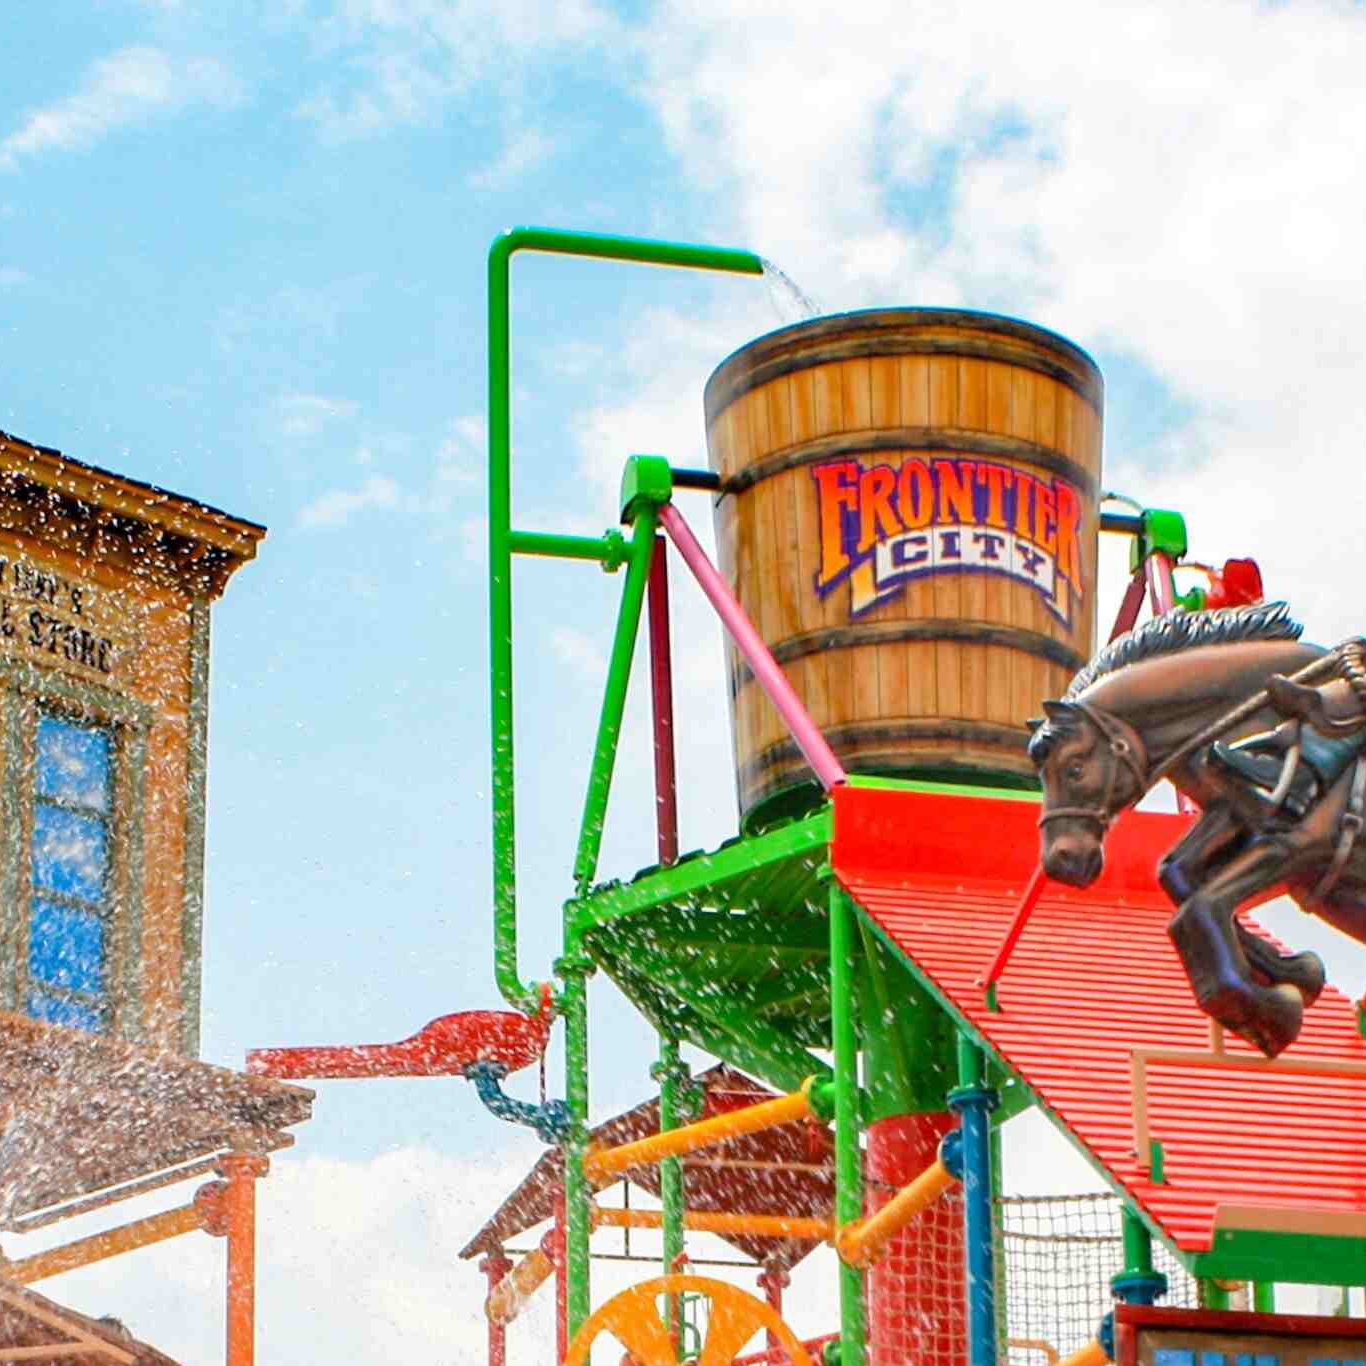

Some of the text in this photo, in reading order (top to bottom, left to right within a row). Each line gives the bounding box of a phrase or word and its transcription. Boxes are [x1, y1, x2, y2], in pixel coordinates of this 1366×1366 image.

[811, 458, 1083, 600] FRONTIER
[890, 530, 1047, 578] CITY
[28, 609, 115, 673] STORE
